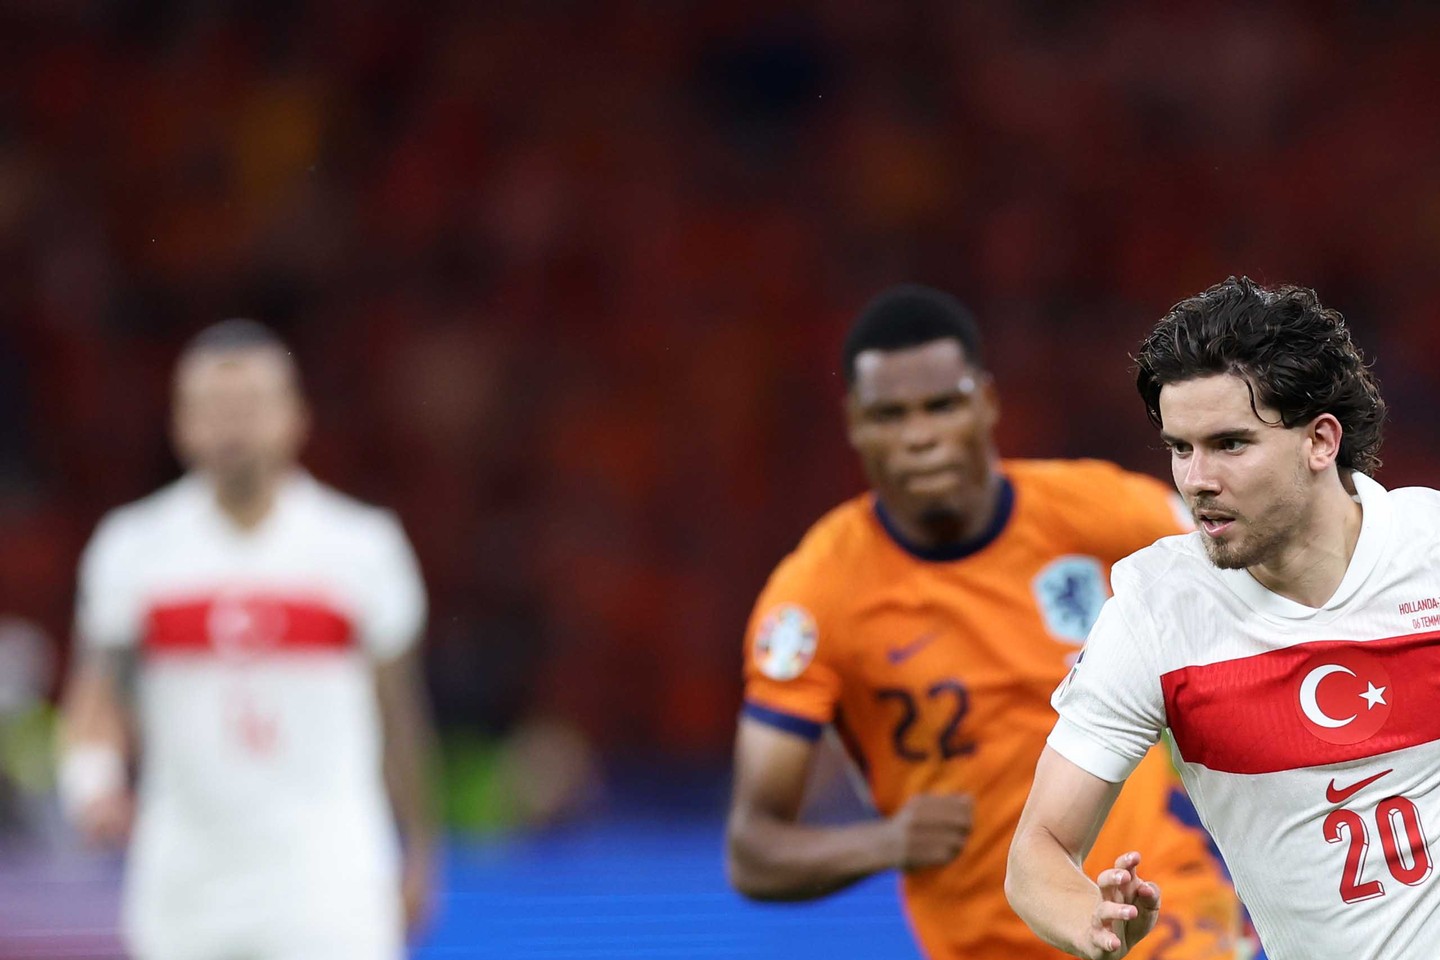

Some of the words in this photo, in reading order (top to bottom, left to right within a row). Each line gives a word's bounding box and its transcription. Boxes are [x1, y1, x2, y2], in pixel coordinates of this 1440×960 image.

[1412, 618, 1421, 629] 06
[876, 677, 977, 763] 22
[1322, 793, 1434, 905] 20
